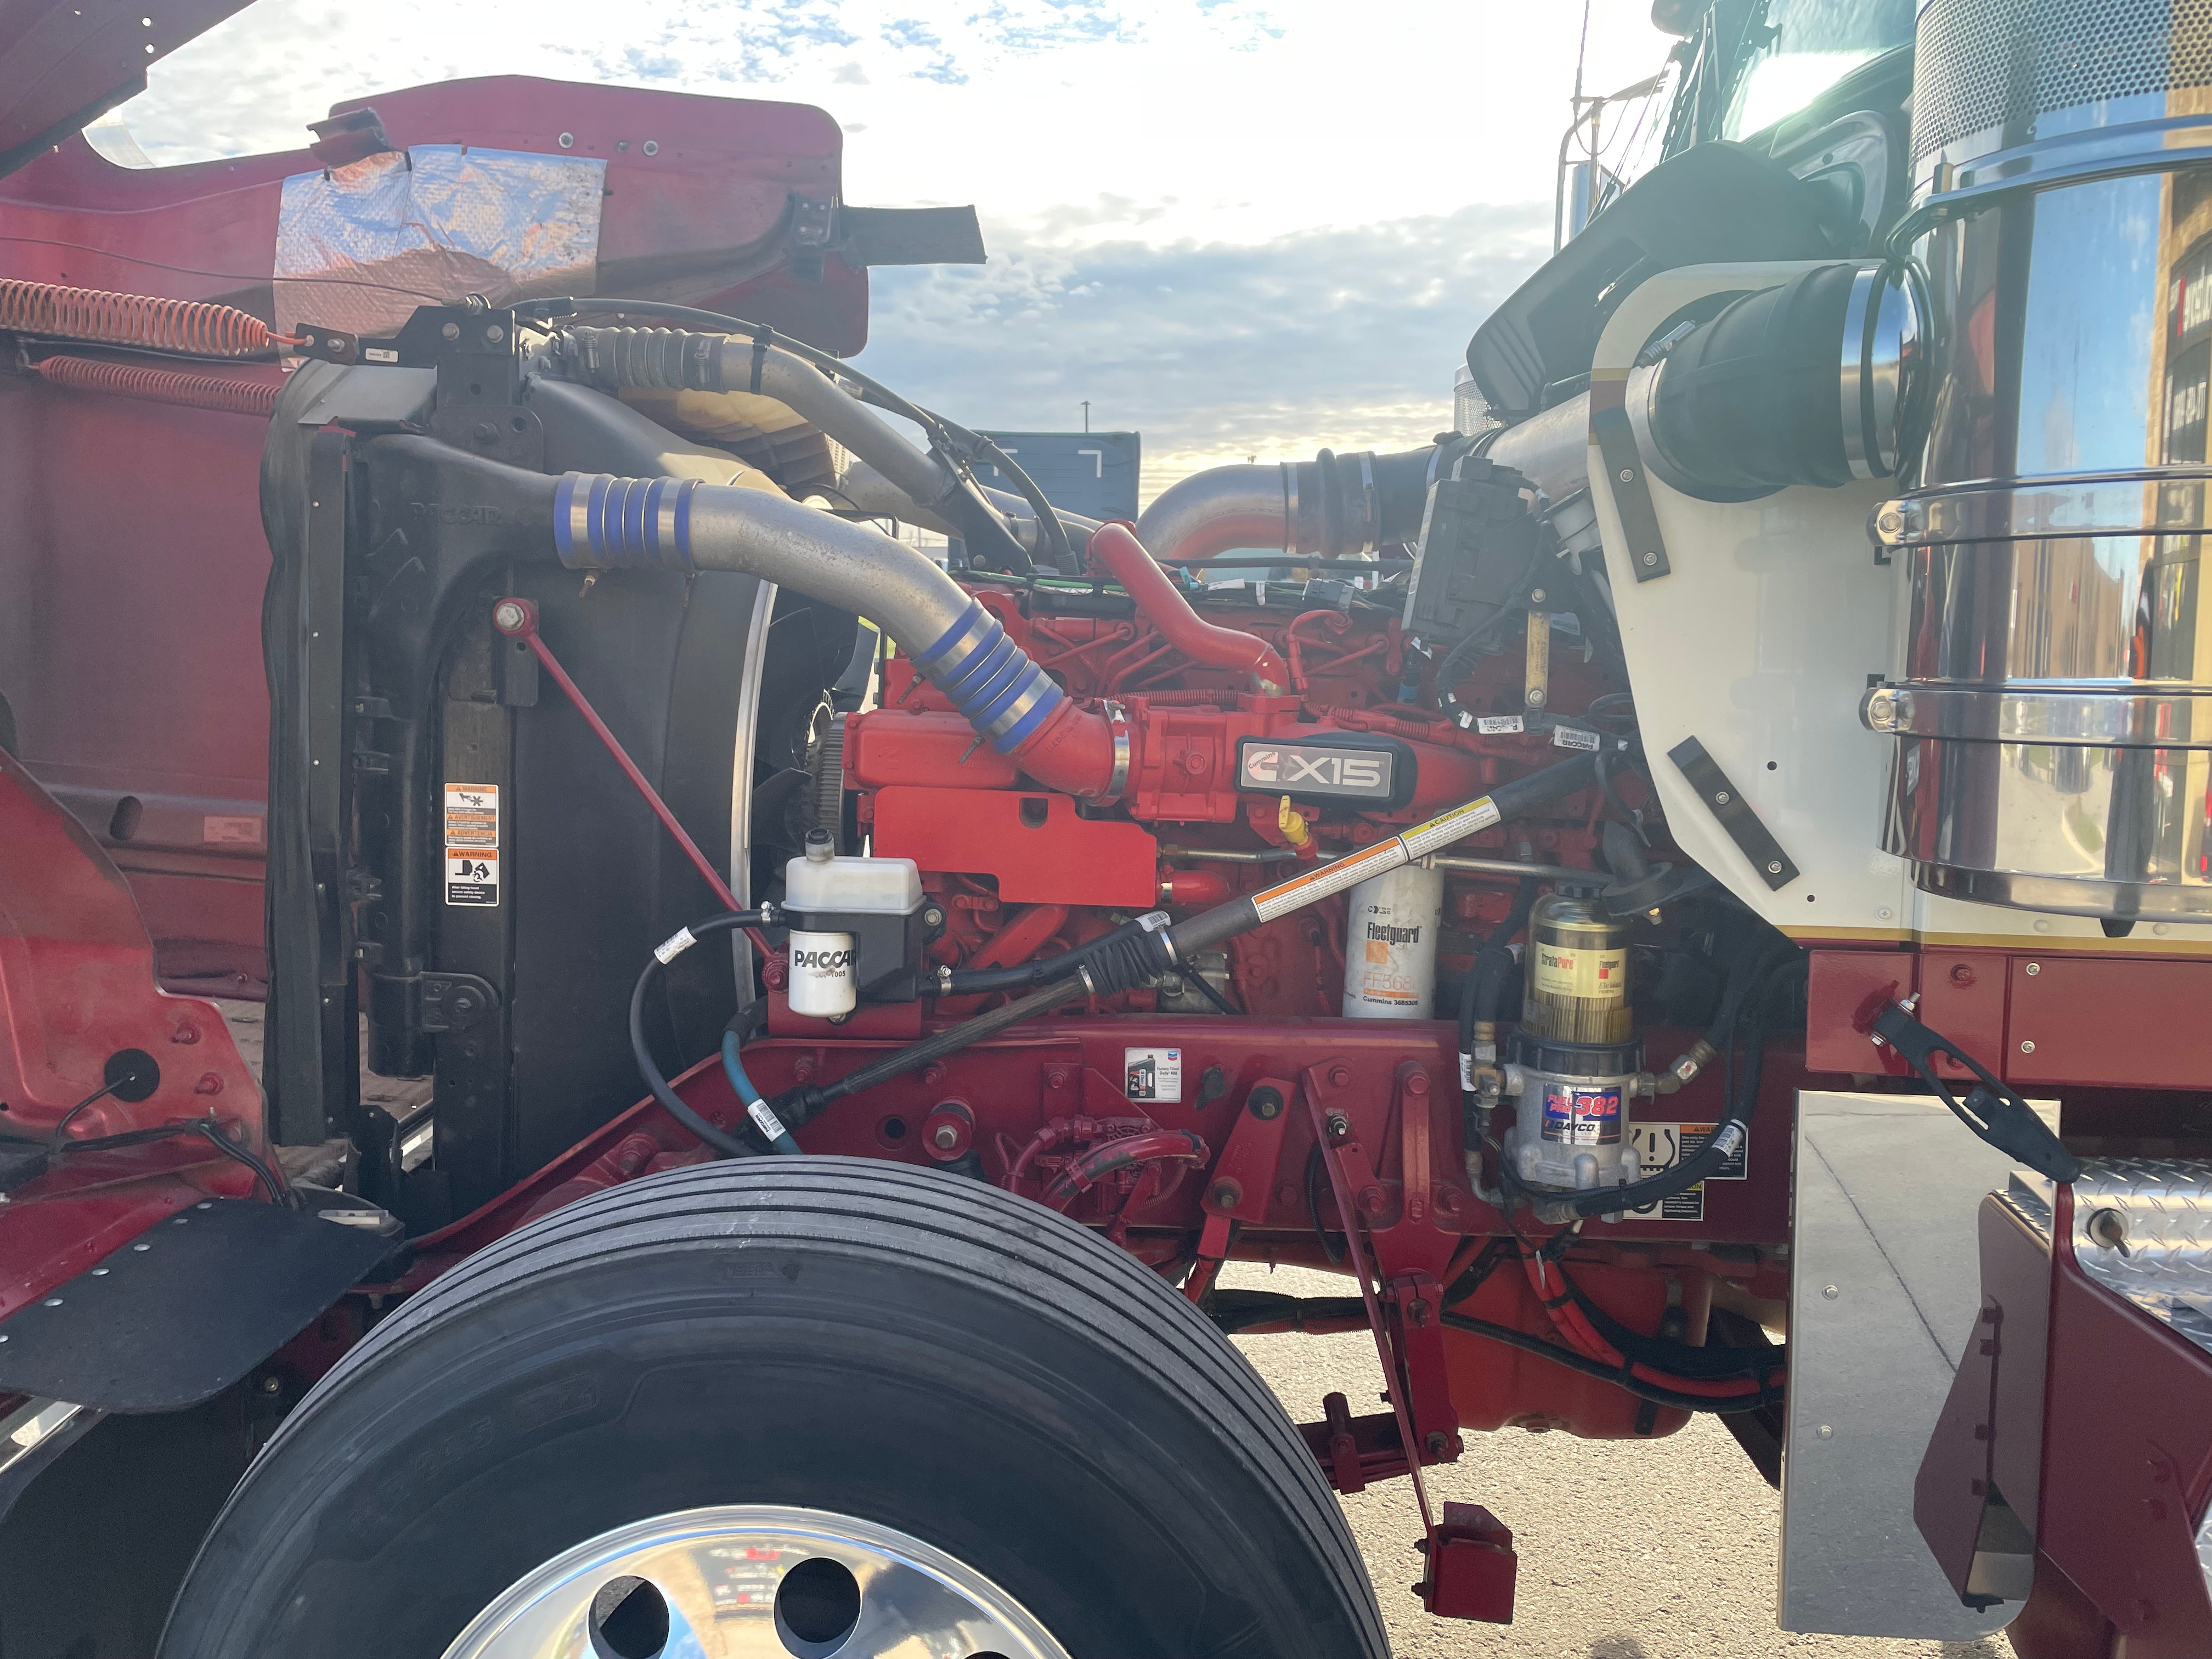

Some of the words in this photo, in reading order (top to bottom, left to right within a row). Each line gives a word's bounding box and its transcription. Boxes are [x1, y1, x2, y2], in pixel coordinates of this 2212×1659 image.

[1562, 739, 1594, 749] PACCAR
[1248, 752, 1277, 769] Cummins
[1286, 755, 1381, 787] X15
[1434, 808, 1465, 826] CAUTION
[1313, 861, 1346, 881] WARNING
[1367, 922, 1420, 946] Fleetguard
[1542, 953, 1573, 970] StrataPore
[1363, 996, 1392, 1005] Cummins
[1548, 1094, 1573, 1105] FUEL
[1575, 1095, 1618, 1116] 382
[1550, 1103, 1571, 1114] PRO
